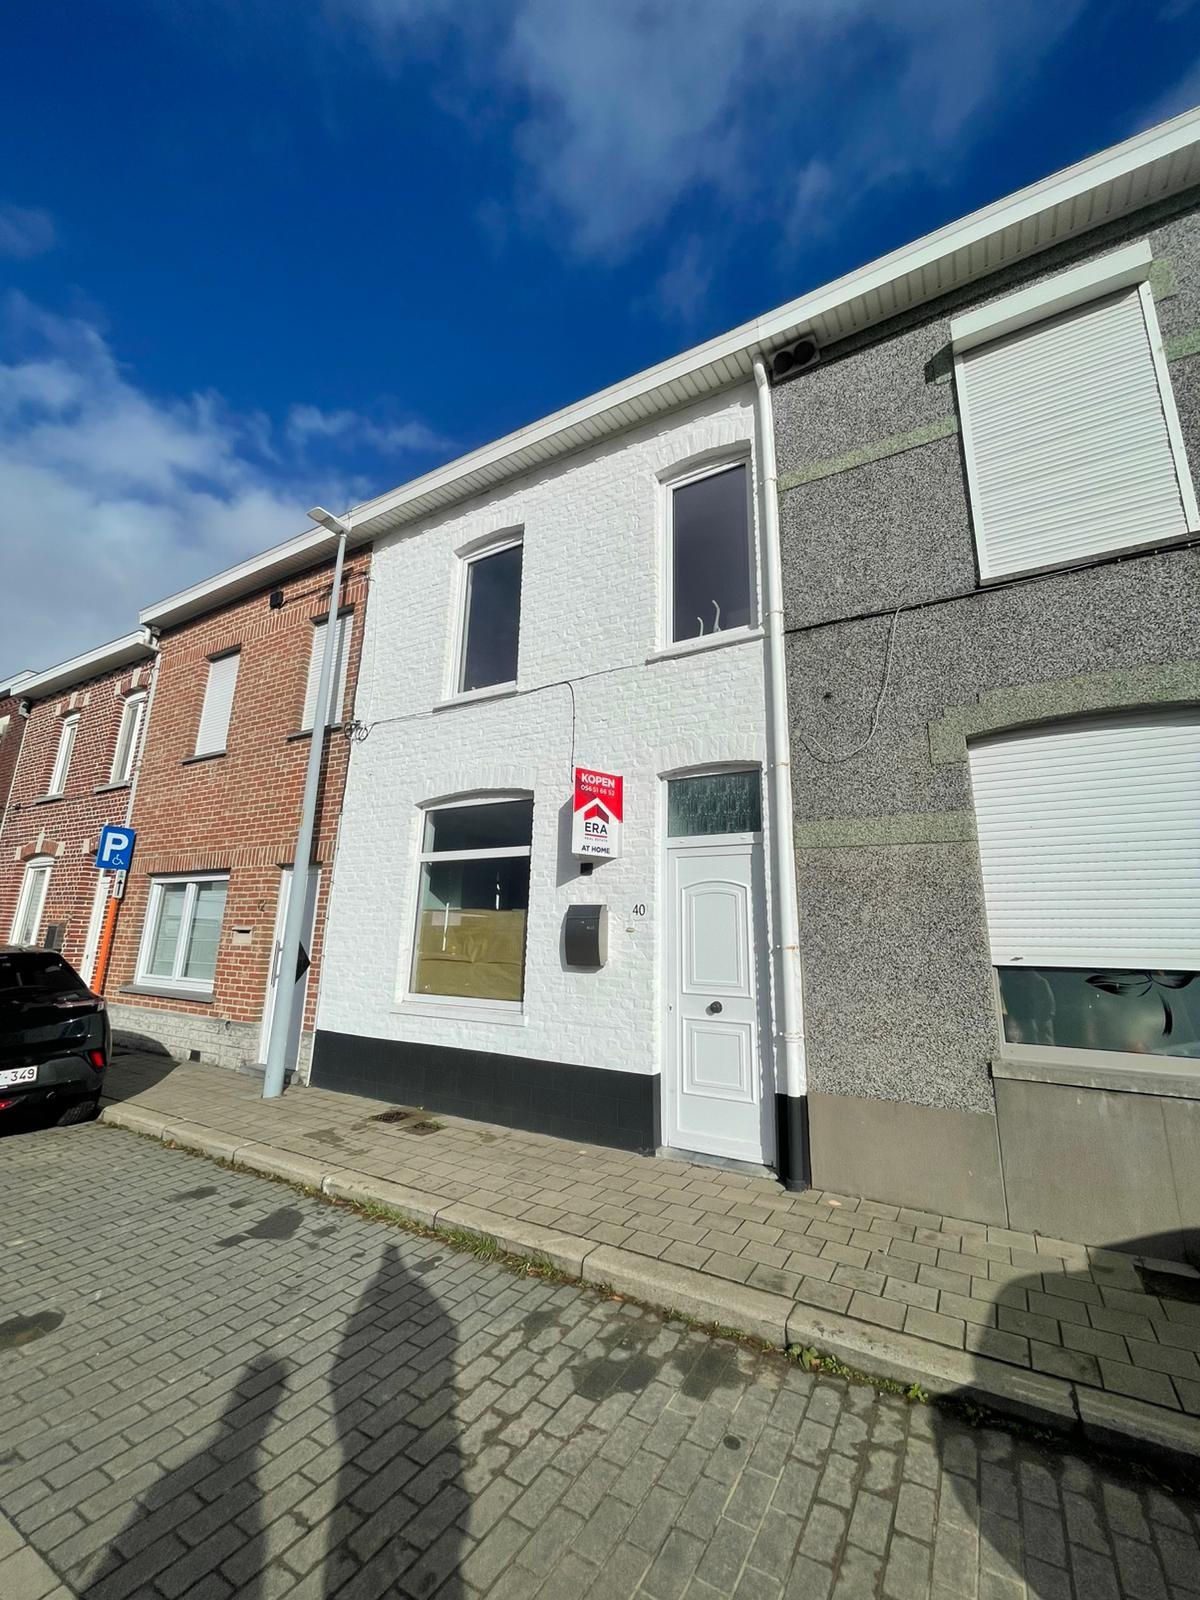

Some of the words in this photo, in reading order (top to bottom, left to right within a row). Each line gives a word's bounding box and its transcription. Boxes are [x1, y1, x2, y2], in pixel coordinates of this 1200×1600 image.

[581, 773, 616, 789] KOPEN
[584, 822, 608, 835] ERA
[102, 832, 129, 862] P
[581, 844, 590, 852] AT
[591, 846, 611, 854] HOME
[632, 904, 646, 916] 40
